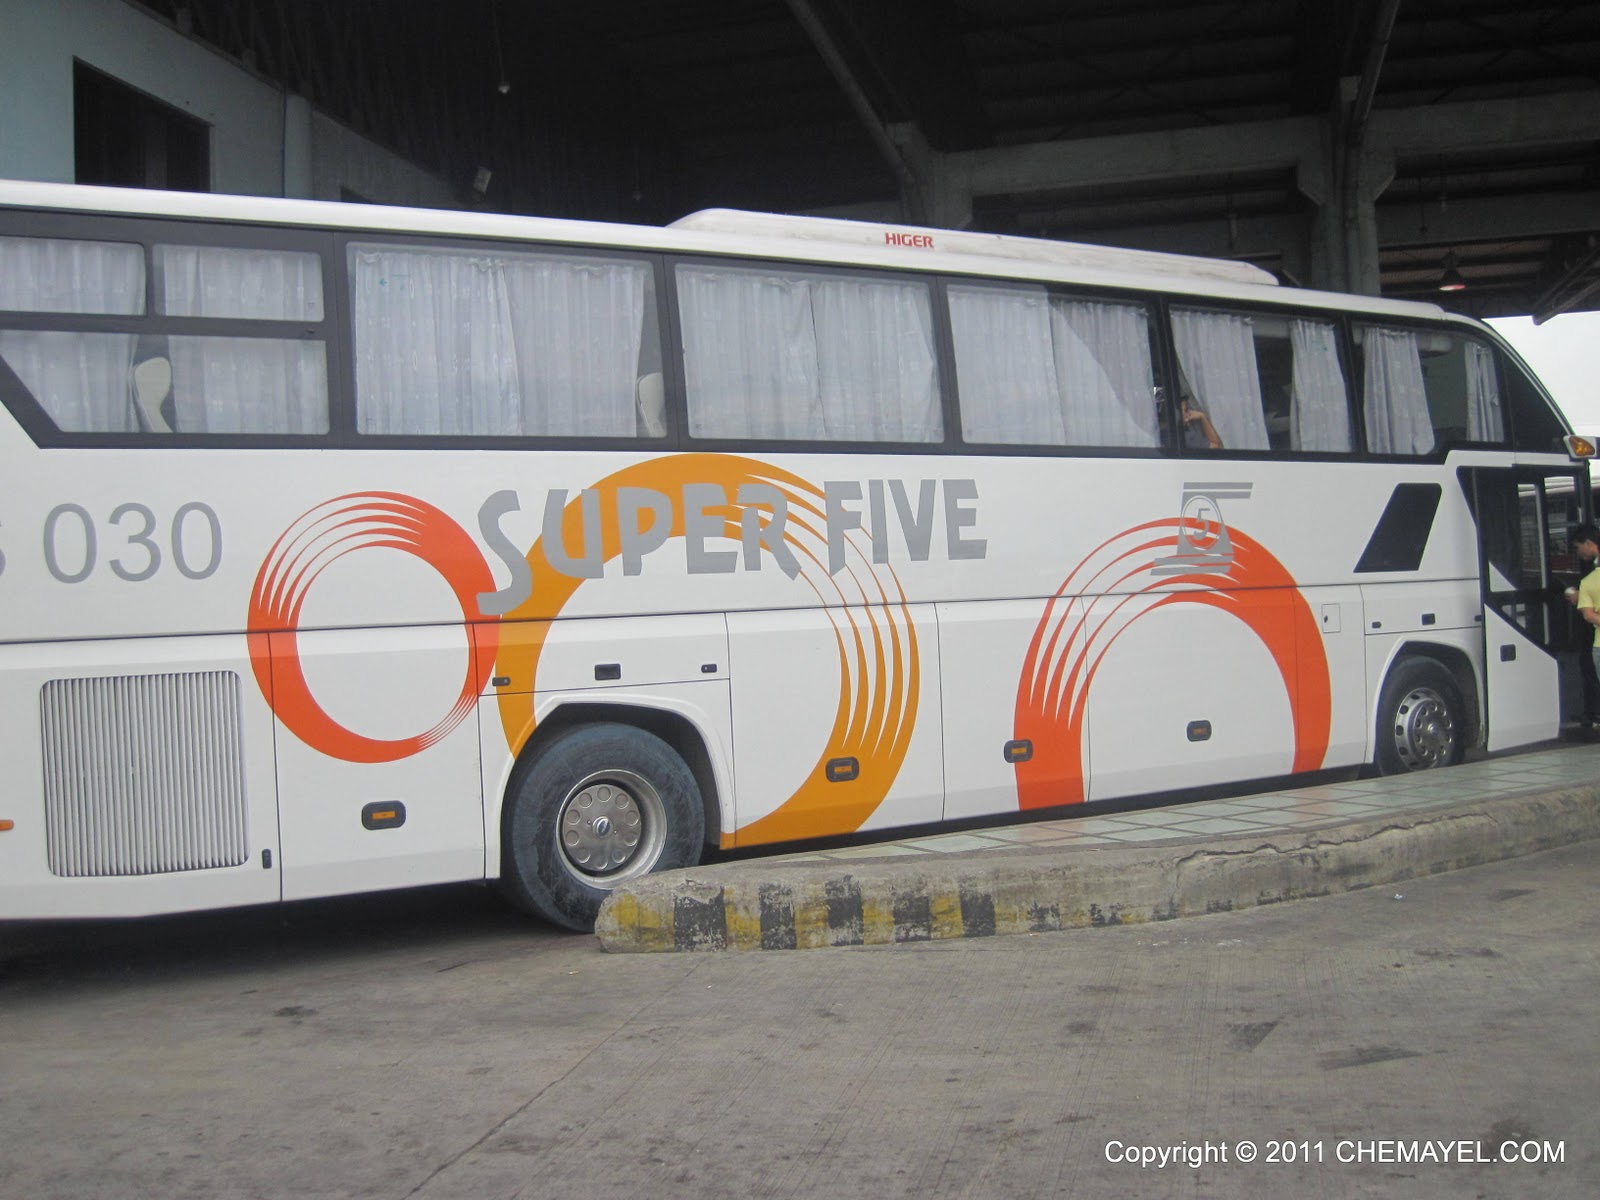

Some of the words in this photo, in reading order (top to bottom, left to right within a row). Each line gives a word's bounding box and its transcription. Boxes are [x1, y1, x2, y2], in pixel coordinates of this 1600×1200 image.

[885, 232, 934, 249] HIGER
[43, 501, 223, 584] 030
[476, 482, 802, 616] SUPER
[823, 478, 988, 578] FIVE
[1193, 507, 1211, 541] 5
